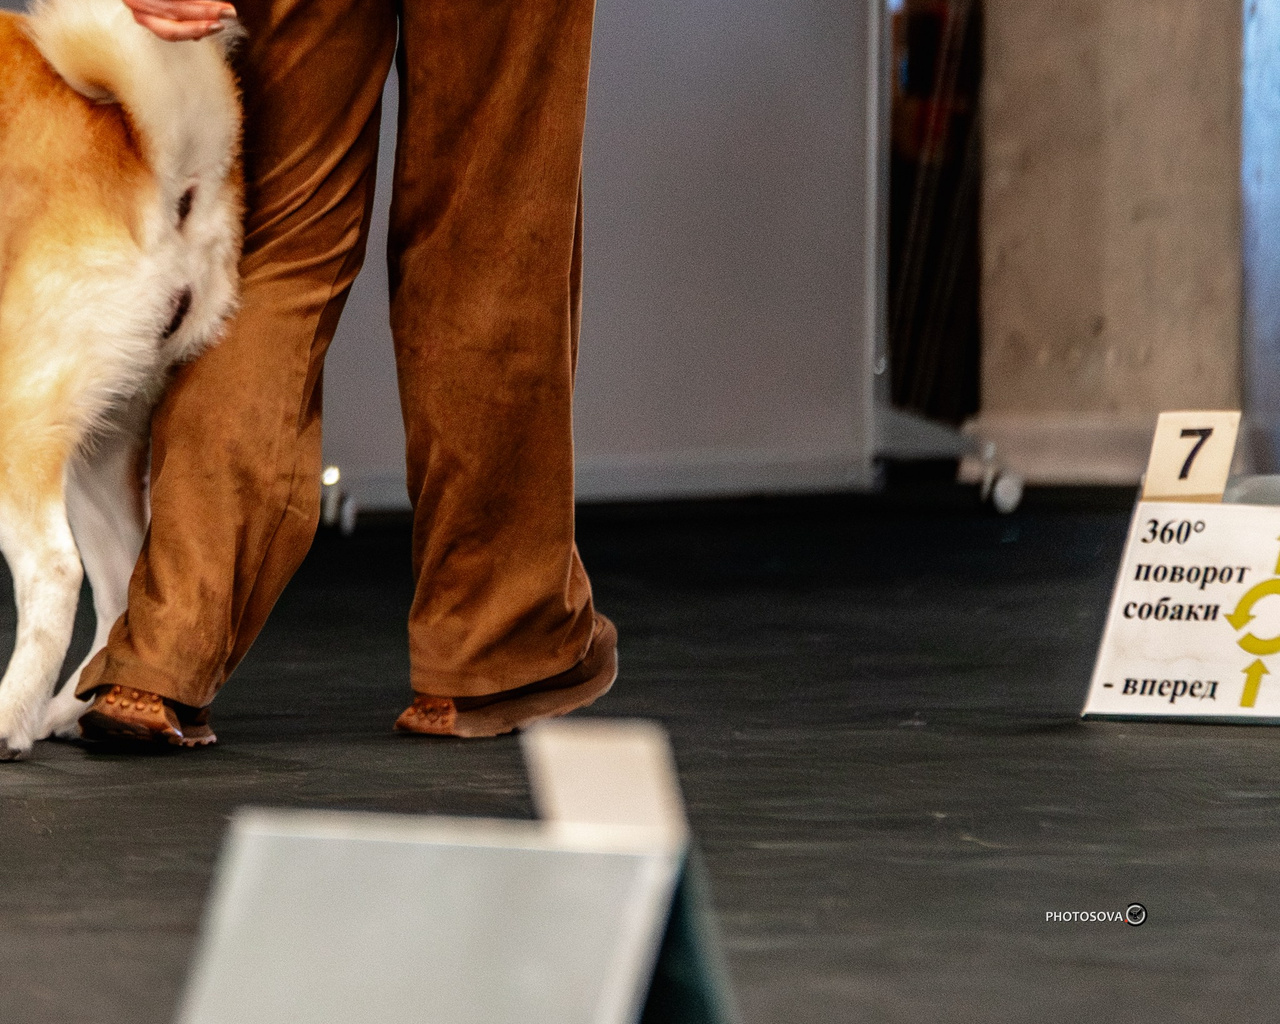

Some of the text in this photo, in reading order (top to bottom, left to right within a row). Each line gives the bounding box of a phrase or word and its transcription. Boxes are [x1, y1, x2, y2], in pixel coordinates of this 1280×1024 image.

[1178, 428, 1214, 480] 7
[1140, 518, 1206, 545] 360°
[1133, 563, 1251, 590] поворот
[1123, 597, 1221, 621] собаки
[1121, 678, 1219, 703] вперед
